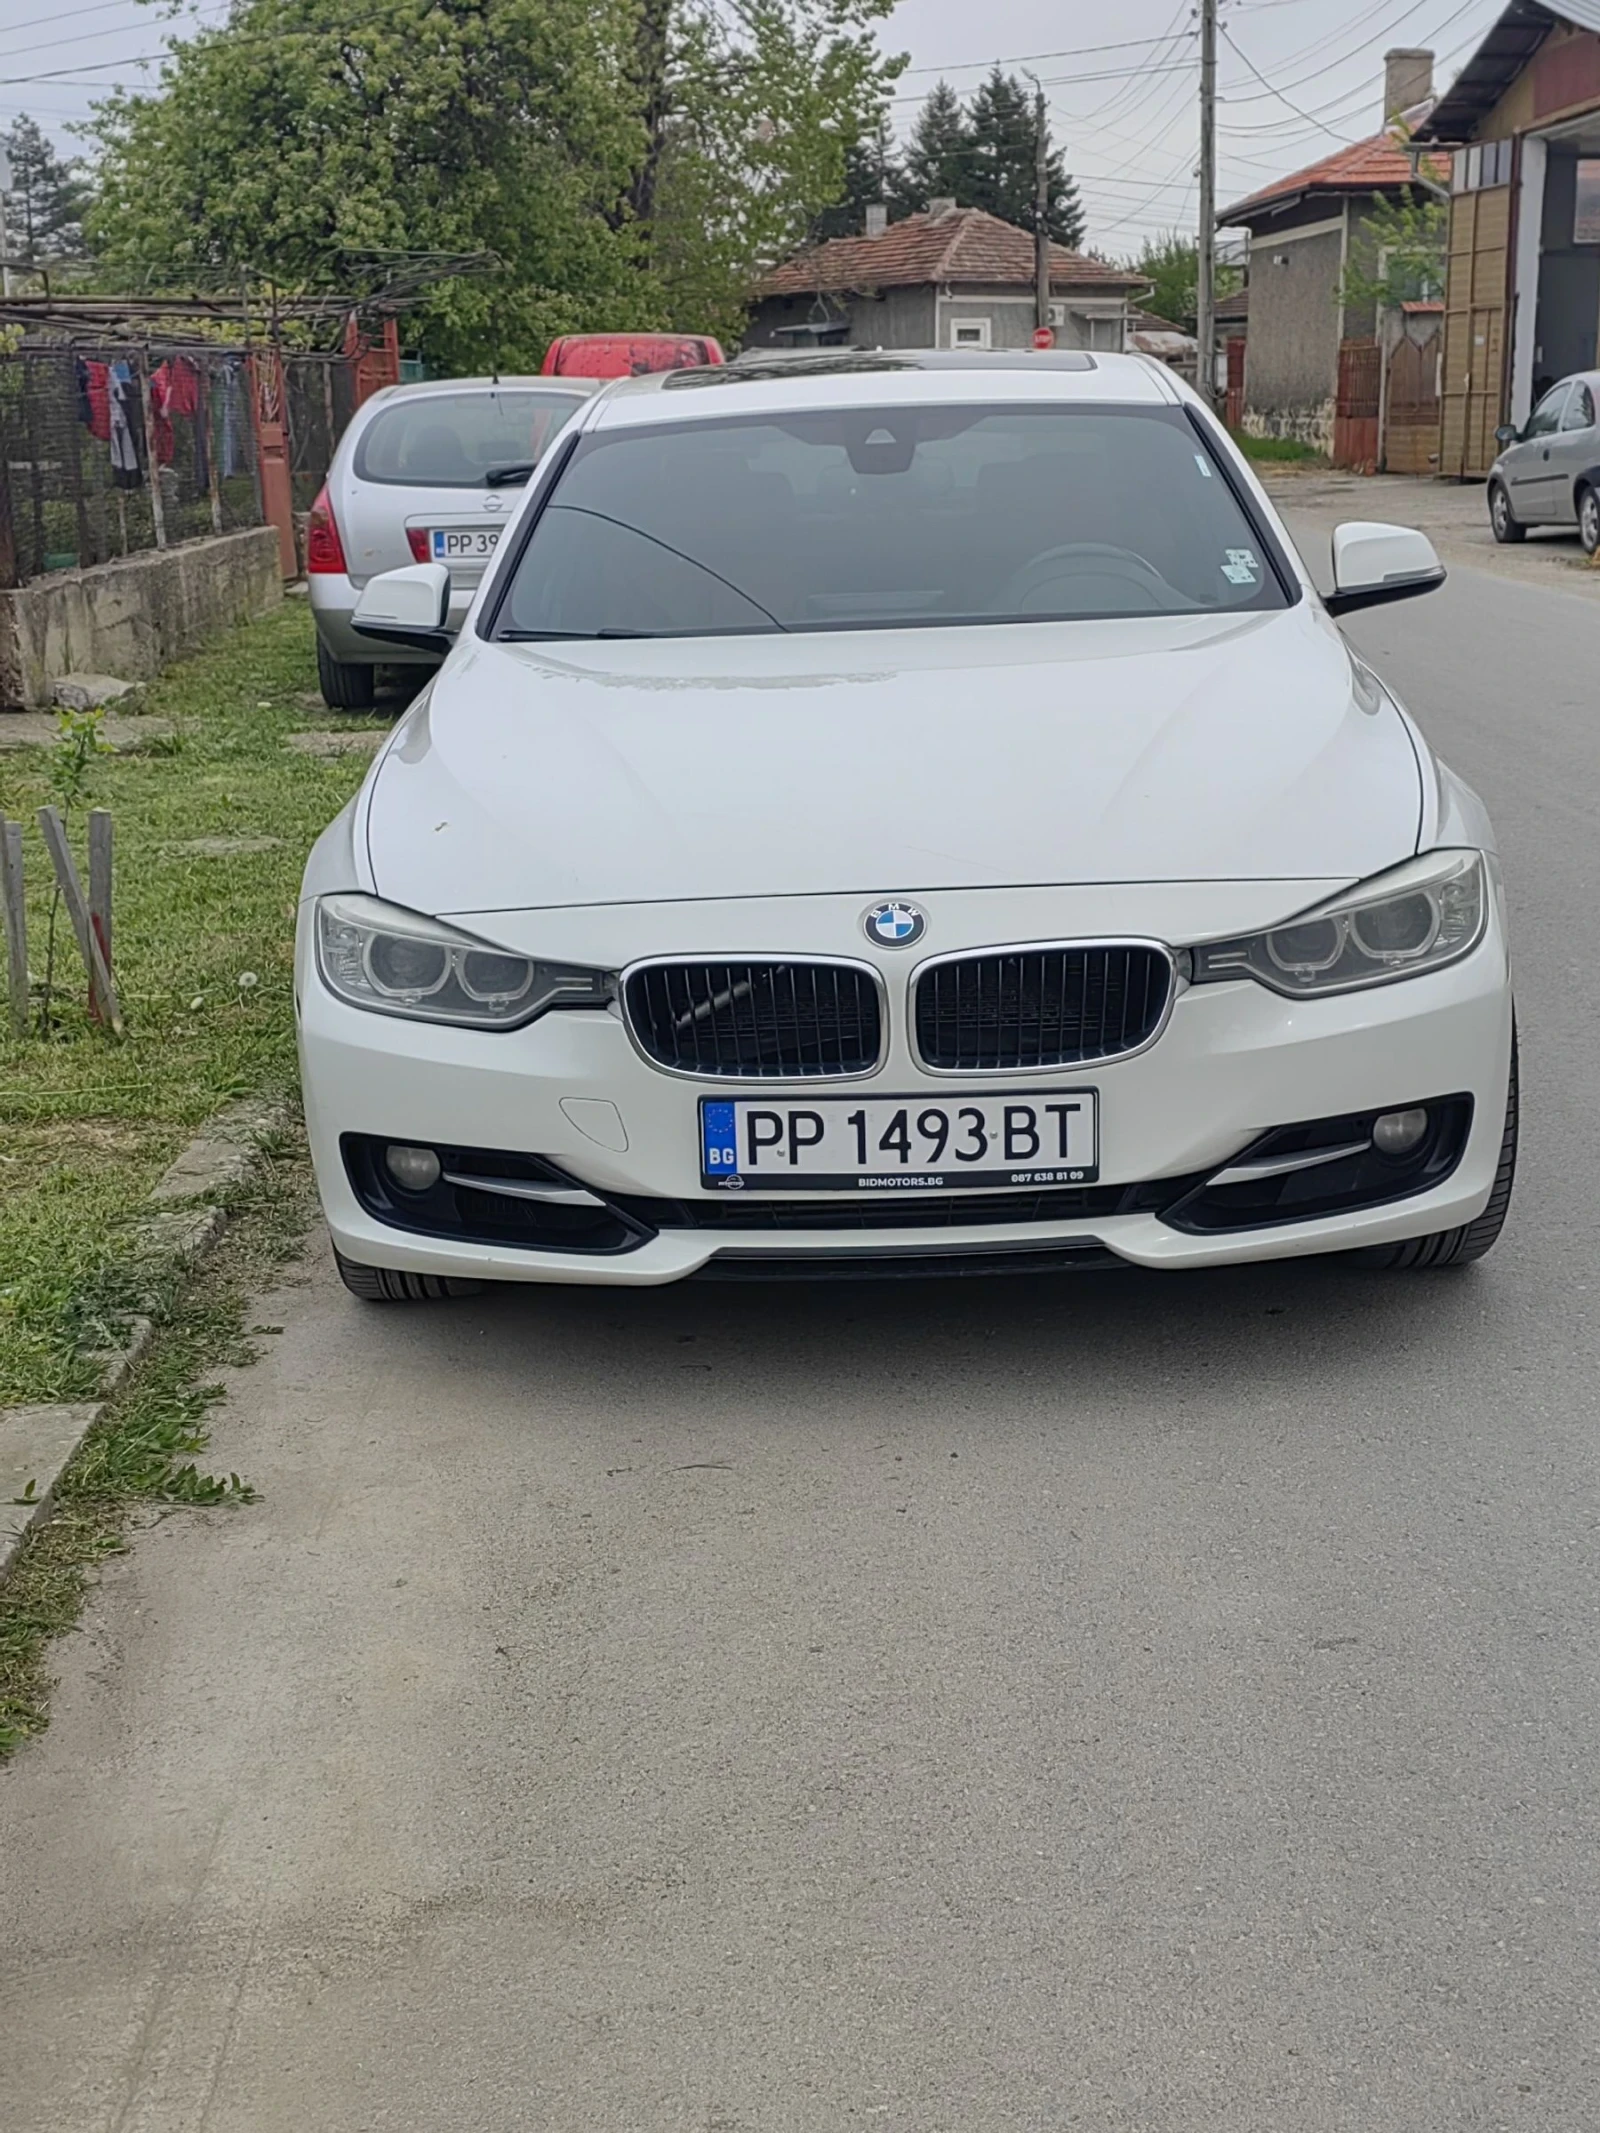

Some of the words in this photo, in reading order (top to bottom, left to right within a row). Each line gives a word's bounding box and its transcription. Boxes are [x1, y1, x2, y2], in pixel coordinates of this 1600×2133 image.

[447, 534, 472, 553] PP
[870, 903, 920, 918] BMW
[747, 1110, 824, 1165] PP
[847, 1107, 988, 1164] 1493
[1004, 1103, 1081, 1160] BT
[709, 1147, 734, 1164] BG
[858, 1177, 943, 1187] BIDMOTORS.BG
[1011, 1173, 1032, 1182] 087
[1034, 1172, 1054, 1181] 638
[1056, 1172, 1067, 1180] 81
[1070, 1171, 1084, 1179] 09
